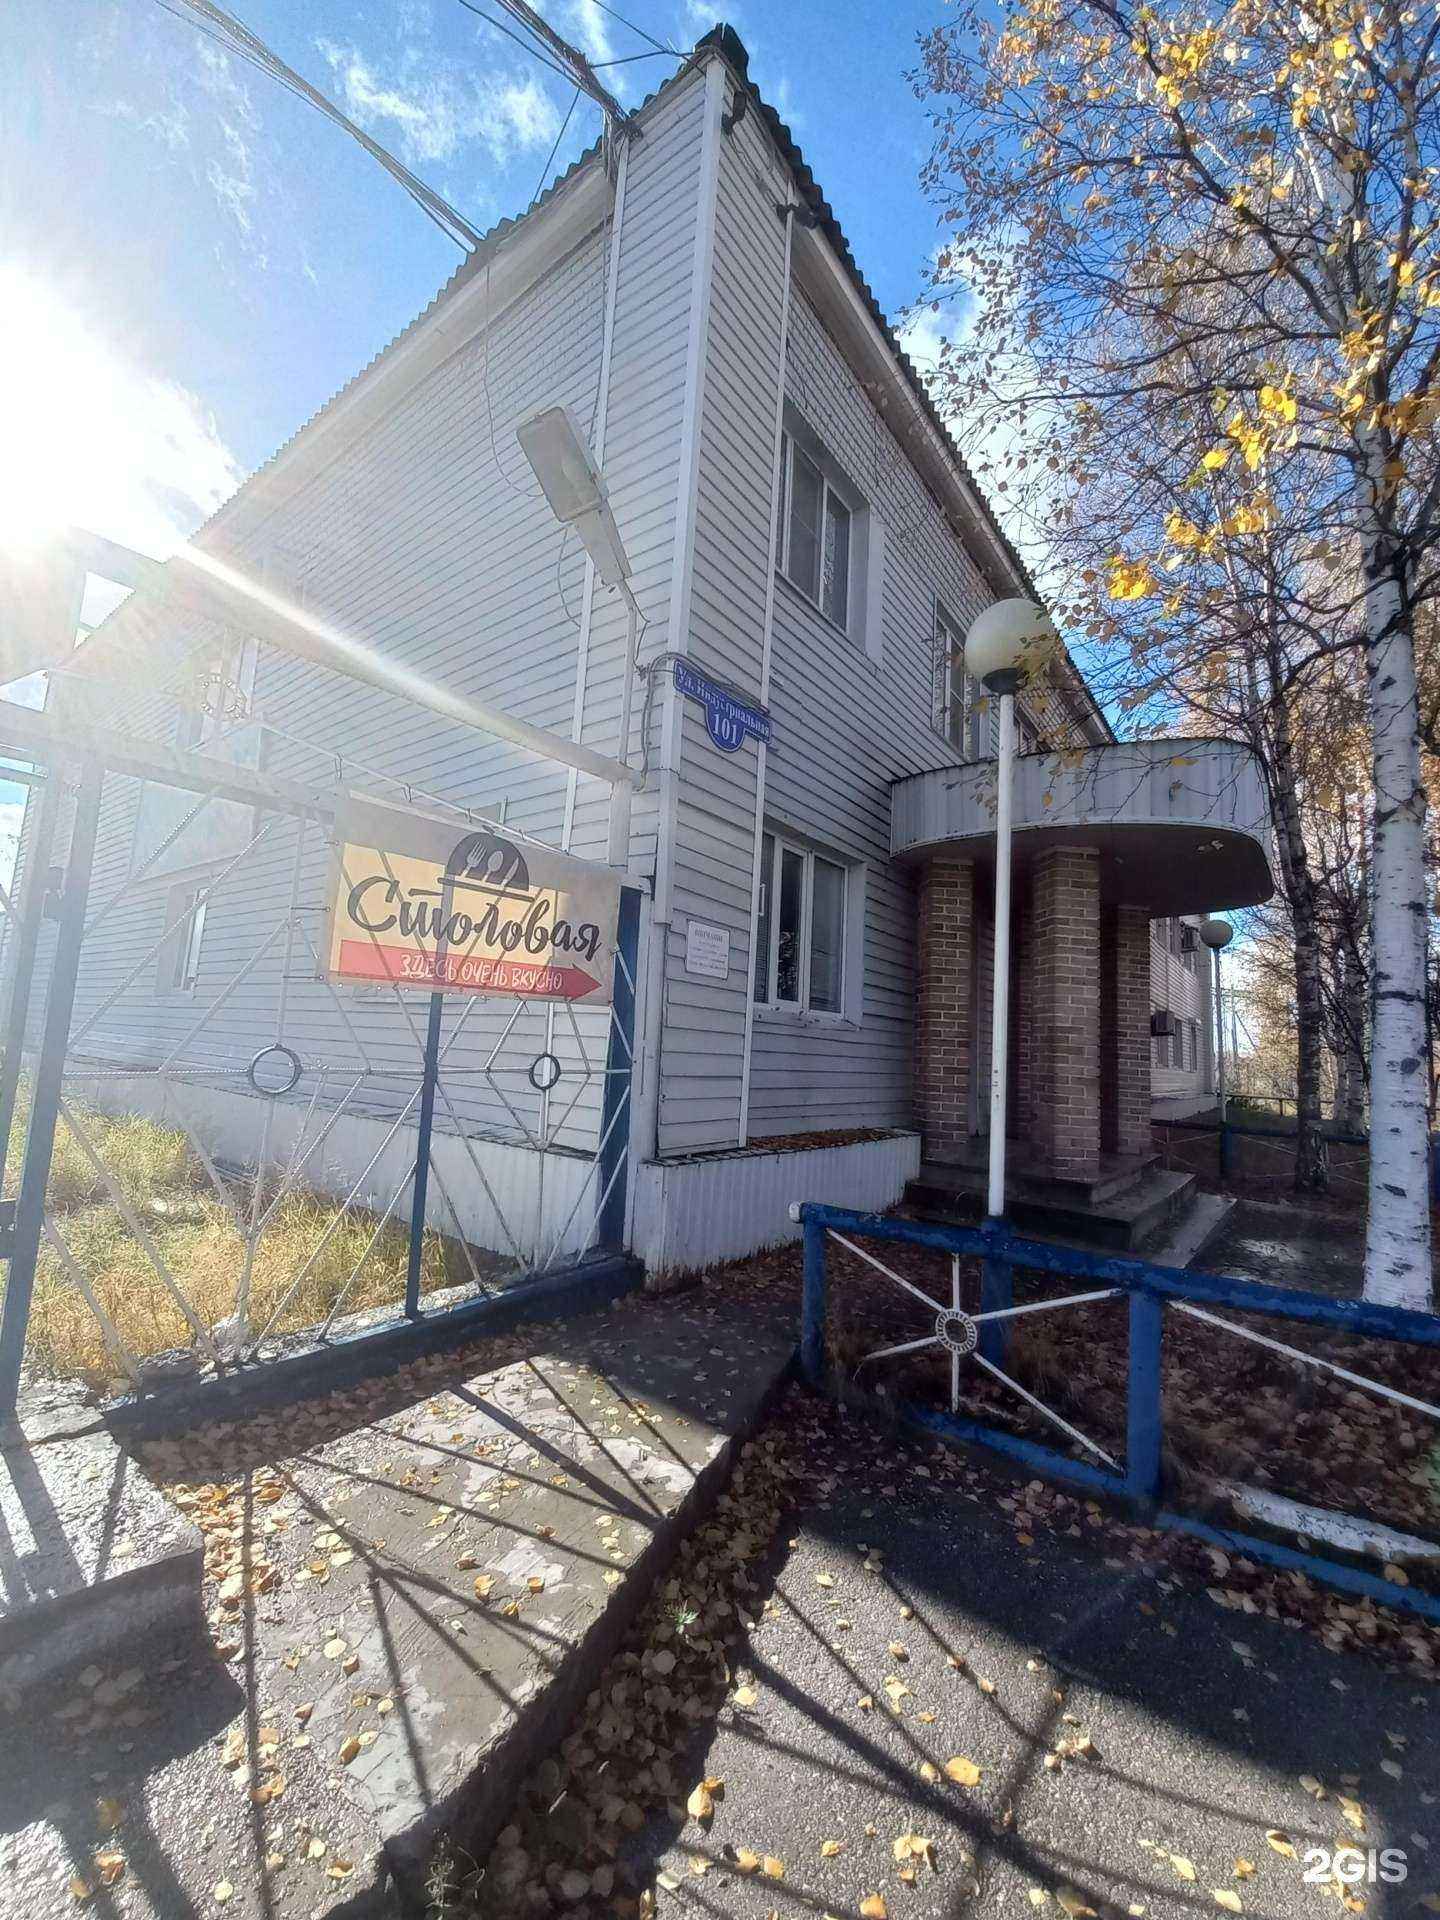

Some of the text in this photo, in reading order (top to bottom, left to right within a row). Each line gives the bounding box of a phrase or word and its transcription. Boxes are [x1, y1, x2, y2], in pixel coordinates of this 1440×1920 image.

[713, 714, 738, 745] 101
[347, 875, 602, 962] Столовая
[399, 953, 563, 992] ЗДЕСЬ ОЧЕНЬ ВКУСНО
